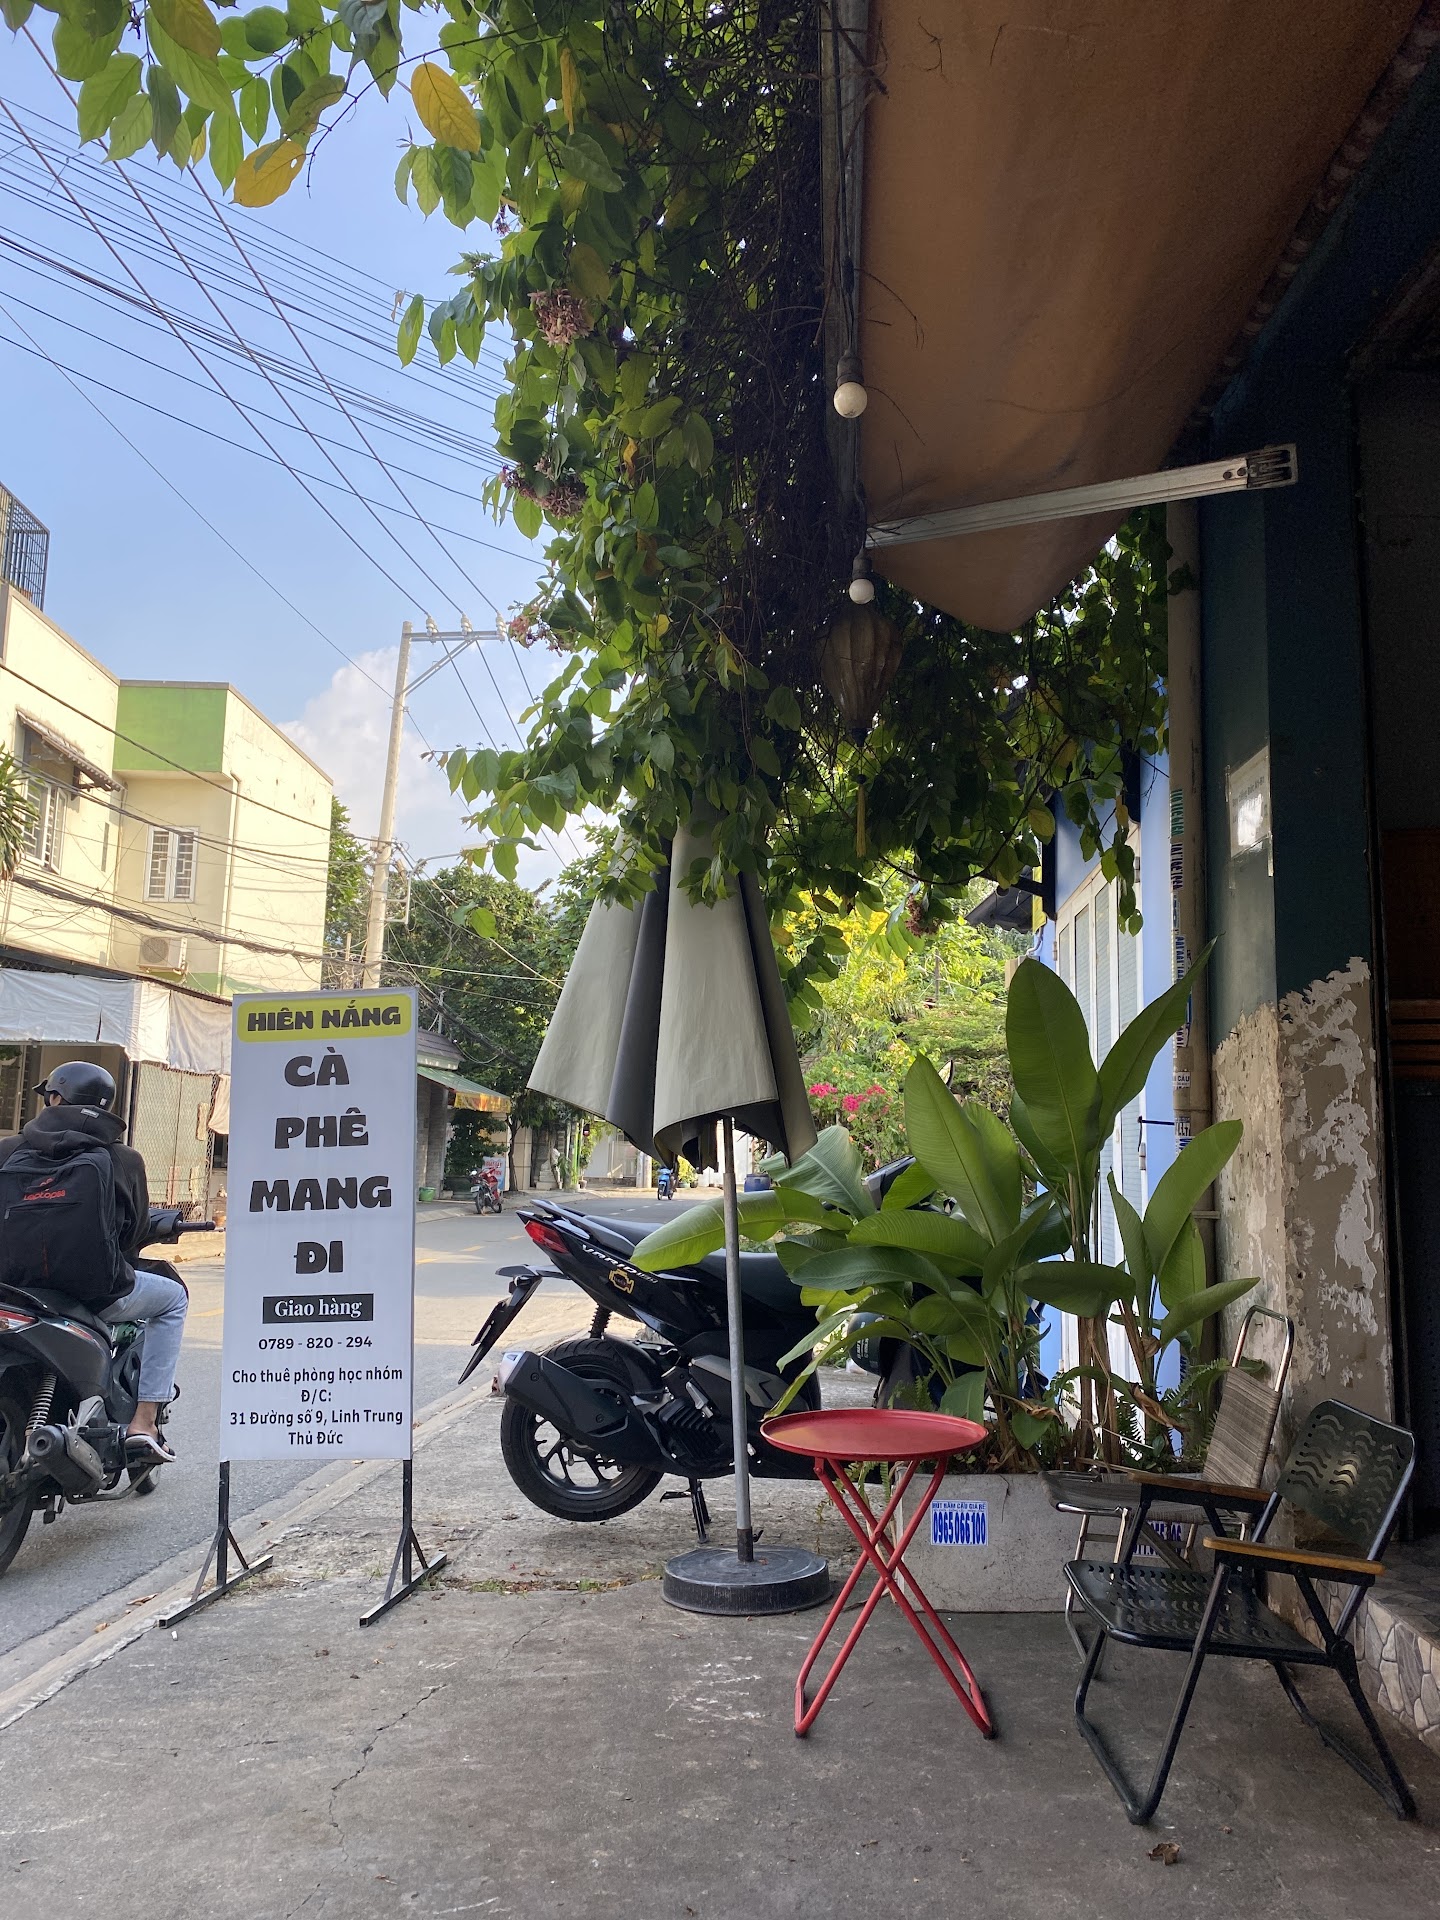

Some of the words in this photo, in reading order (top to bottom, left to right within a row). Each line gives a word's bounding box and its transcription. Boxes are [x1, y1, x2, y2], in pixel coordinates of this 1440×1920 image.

[247, 1007, 314, 1032] HIÊN
[321, 999, 401, 1029] NẮNG
[284, 1046, 350, 1087] CÀ
[274, 1106, 369, 1149] PHÊ
[249, 1175, 392, 1212] MANG
[293, 1240, 344, 1274] ĐI
[582, 1244, 637, 1273] VARIO
[274, 1300, 315, 1317] Giao
[318, 1297, 363, 1318] hàng
[258, 1338, 294, 1350] 0789
[306, 1337, 334, 1349] 820
[345, 1336, 373, 1348] 294
[232, 1369, 257, 1383] Cho
[260, 1368, 291, 1382] thuê
[293, 1367, 335, 1384] phòng
[338, 1367, 362, 1383] học
[365, 1365, 403, 1380] nhóm
[300, 1389, 332, 1404] Đ/C:
[230, 1412, 246, 1425] 31
[249, 1409, 294, 1426] Đường
[297, 1409, 313, 1424] số
[315, 1411, 328, 1426] 9,
[331, 1409, 360, 1423] Linh
[363, 1409, 403, 1425] Trung
[288, 1431, 313, 1445] Thủ
[316, 1430, 344, 1444] Đức
[933, 1512, 986, 1544] 0965.066.100
